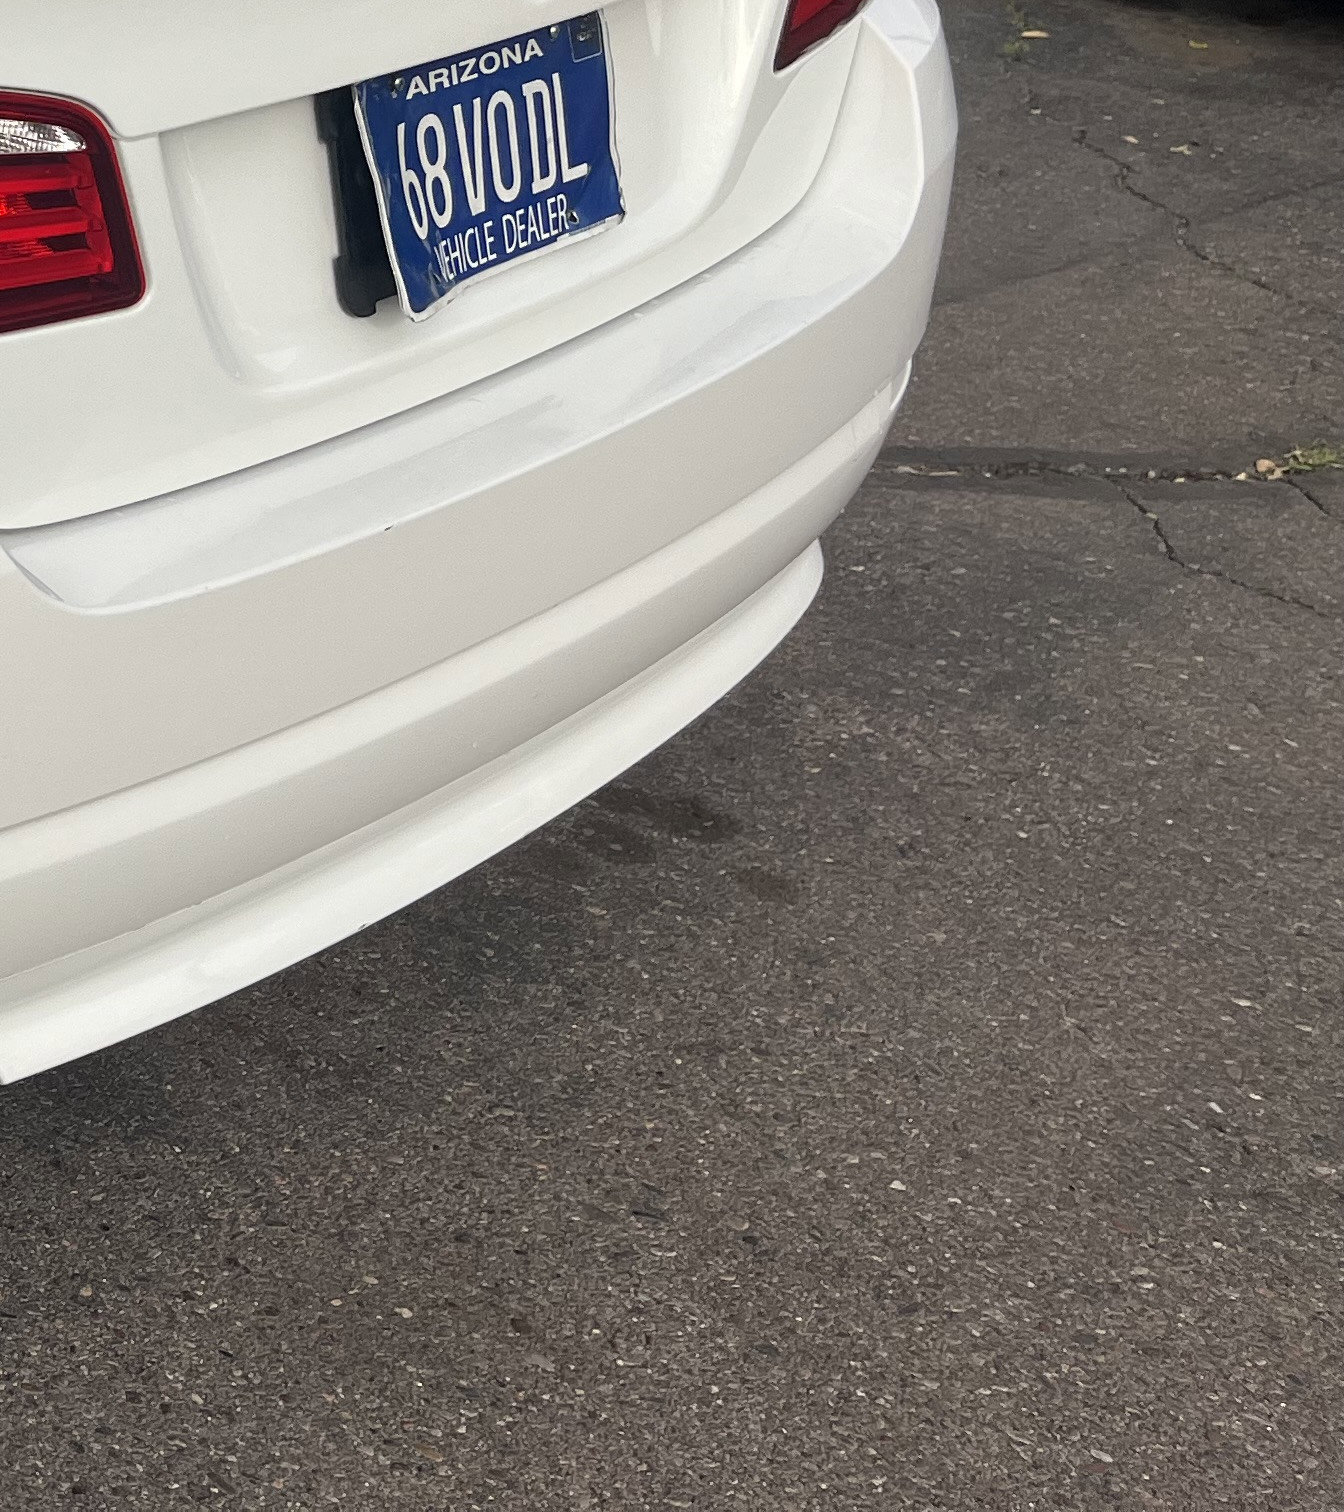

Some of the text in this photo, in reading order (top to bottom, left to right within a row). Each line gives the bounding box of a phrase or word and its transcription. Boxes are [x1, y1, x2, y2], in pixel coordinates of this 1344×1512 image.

[406, 38, 543, 99] ARIZONA
[434, 193, 570, 283] VEHICLE DEALER
